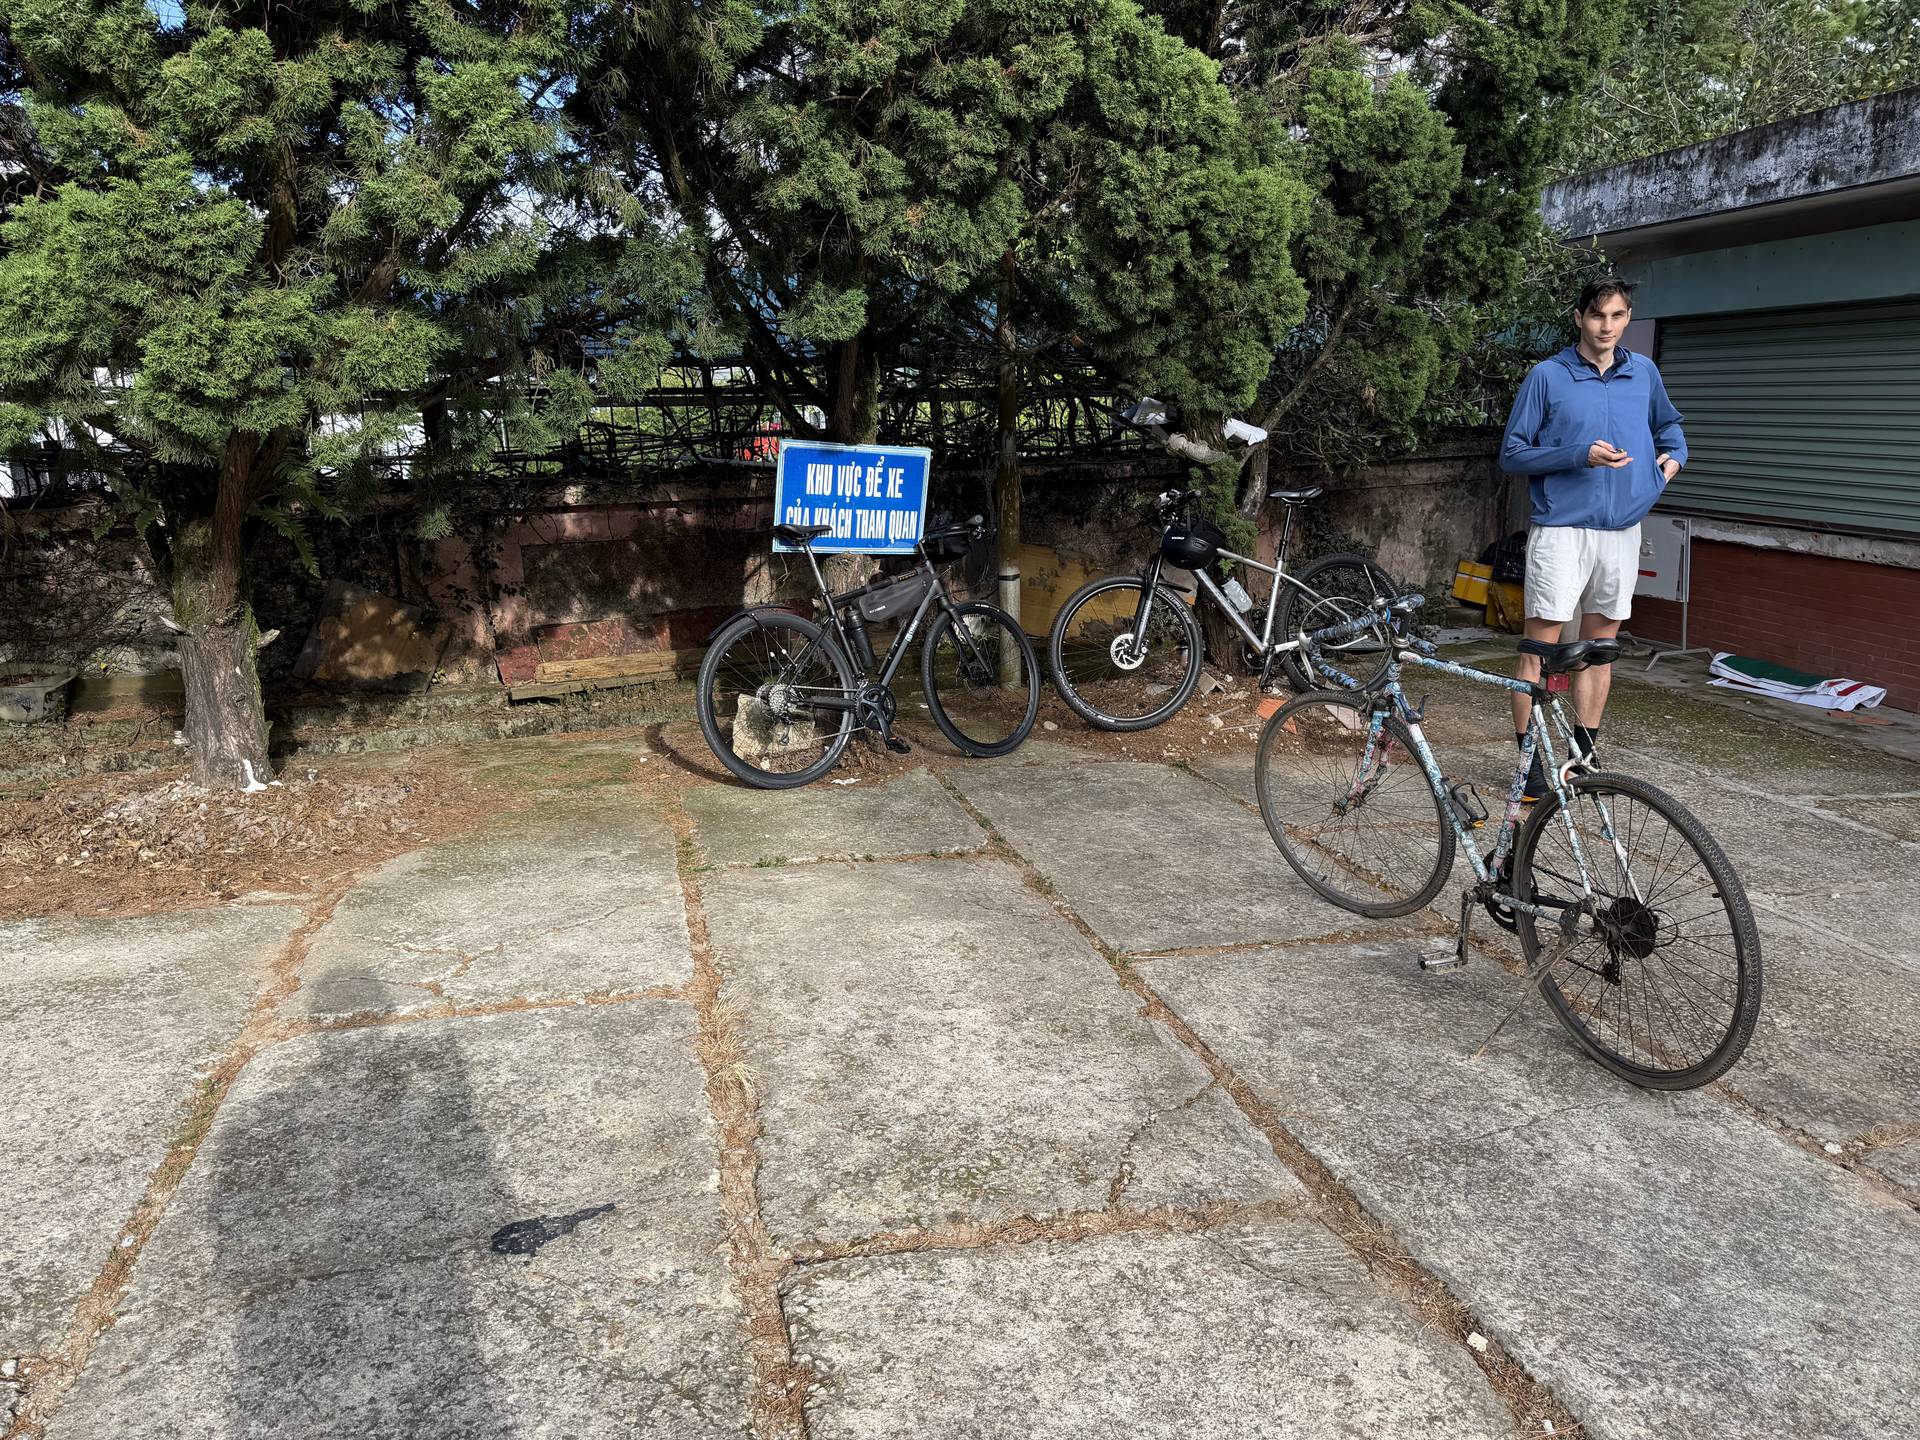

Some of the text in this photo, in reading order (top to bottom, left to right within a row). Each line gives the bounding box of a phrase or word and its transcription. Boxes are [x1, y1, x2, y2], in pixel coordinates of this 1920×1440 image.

[806, 456, 905, 503] KHU VỰC ĐỂ XE
[814, 502, 853, 538] KHÁCH
[855, 509, 887, 539] THAM
[888, 510, 918, 543] QUAN
